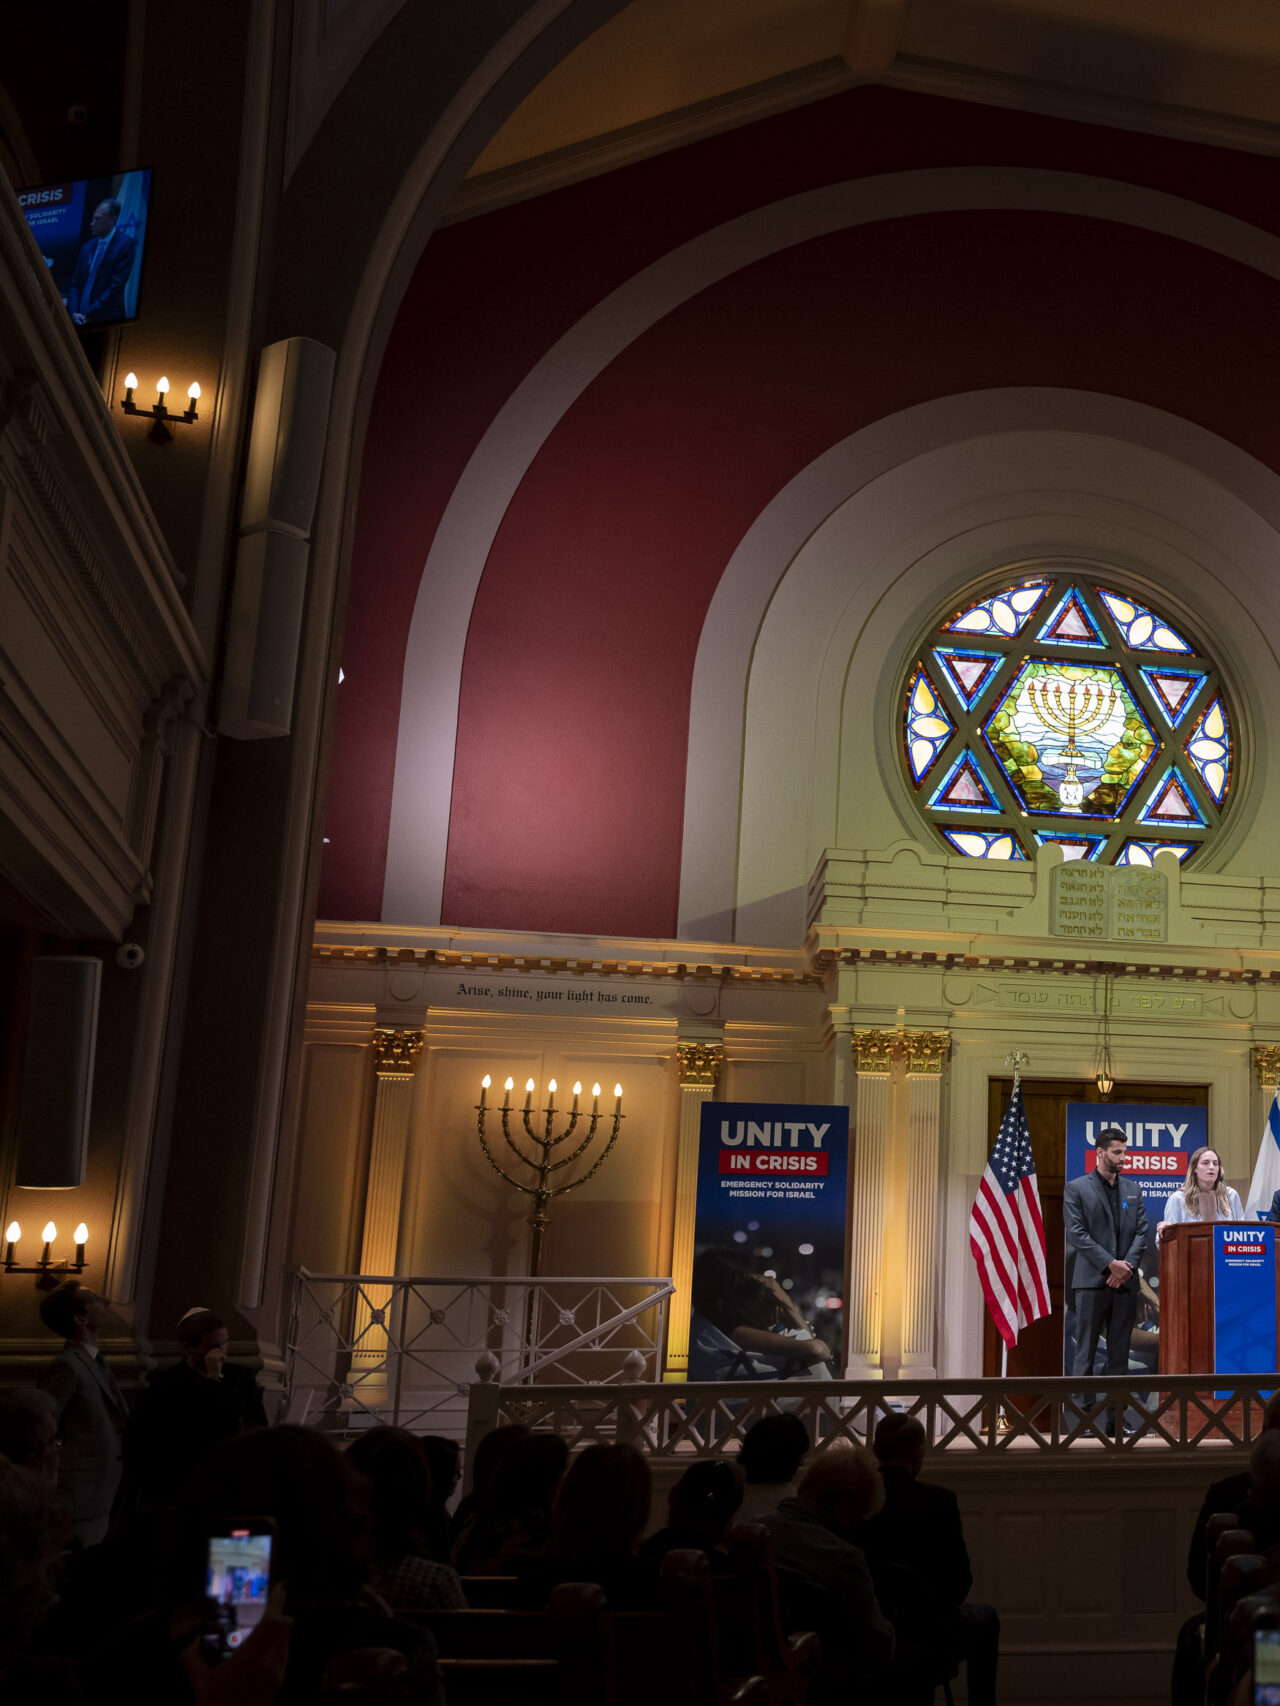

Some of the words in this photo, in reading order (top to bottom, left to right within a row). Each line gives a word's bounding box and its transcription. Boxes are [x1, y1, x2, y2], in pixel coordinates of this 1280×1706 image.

[18, 188, 63, 207] CRISIS
[456, 983, 494, 998] Arise,
[497, 986, 532, 1000] shine,
[536, 990, 564, 1002] your
[567, 989, 593, 1003] light
[597, 991, 617, 1003] has
[621, 994, 653, 1004] come.
[720, 1120, 831, 1148] UNITY
[1086, 1121, 1189, 1148] UNITY
[730, 1154, 750, 1169] IN
[755, 1155, 818, 1171] CRISIS
[1122, 1155, 1178, 1170] CRISIS
[721, 1180, 773, 1188] EMERGENCY
[774, 1181, 825, 1189] SOLIDARITY
[1138, 1181, 1185, 1189] SOLIDARITY
[729, 1190, 765, 1198] MISSION
[786, 1191, 816, 1199] ISRAEL
[1149, 1190, 1174, 1198] ISRAE
[1223, 1231, 1265, 1242] UNITY
